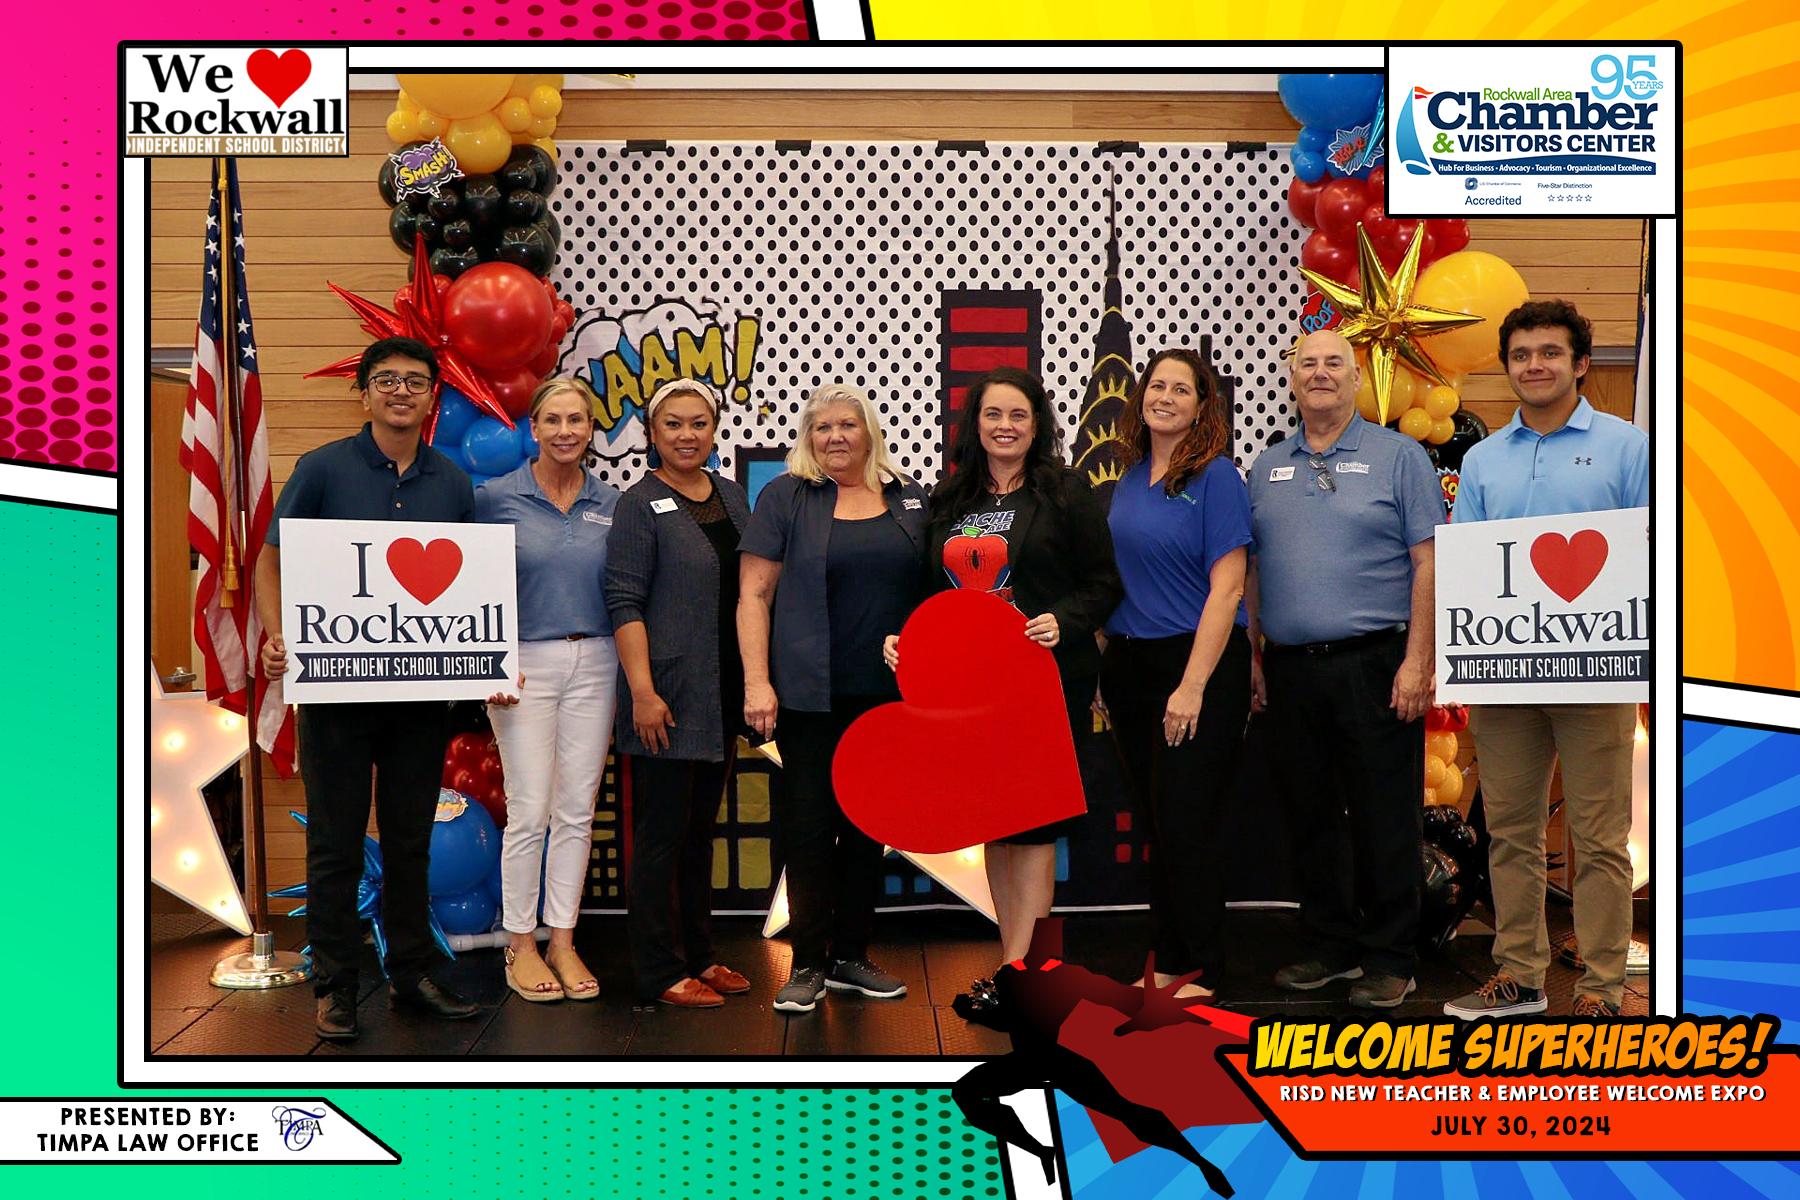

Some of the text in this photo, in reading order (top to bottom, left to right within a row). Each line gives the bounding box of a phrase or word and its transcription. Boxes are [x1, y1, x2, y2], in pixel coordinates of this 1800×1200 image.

[577, 317, 759, 431] AAM!
[350, 542, 374, 598] I
[1496, 541, 1517, 599] I
[295, 602, 507, 645] Rockwall
[1446, 597, 1649, 647] Rockwall
[308, 656, 493, 678] INDEPENDENT SCHOOL DISTRICT
[1457, 655, 1642, 680] INDEPENDENT SCHOOL DISTRICT
